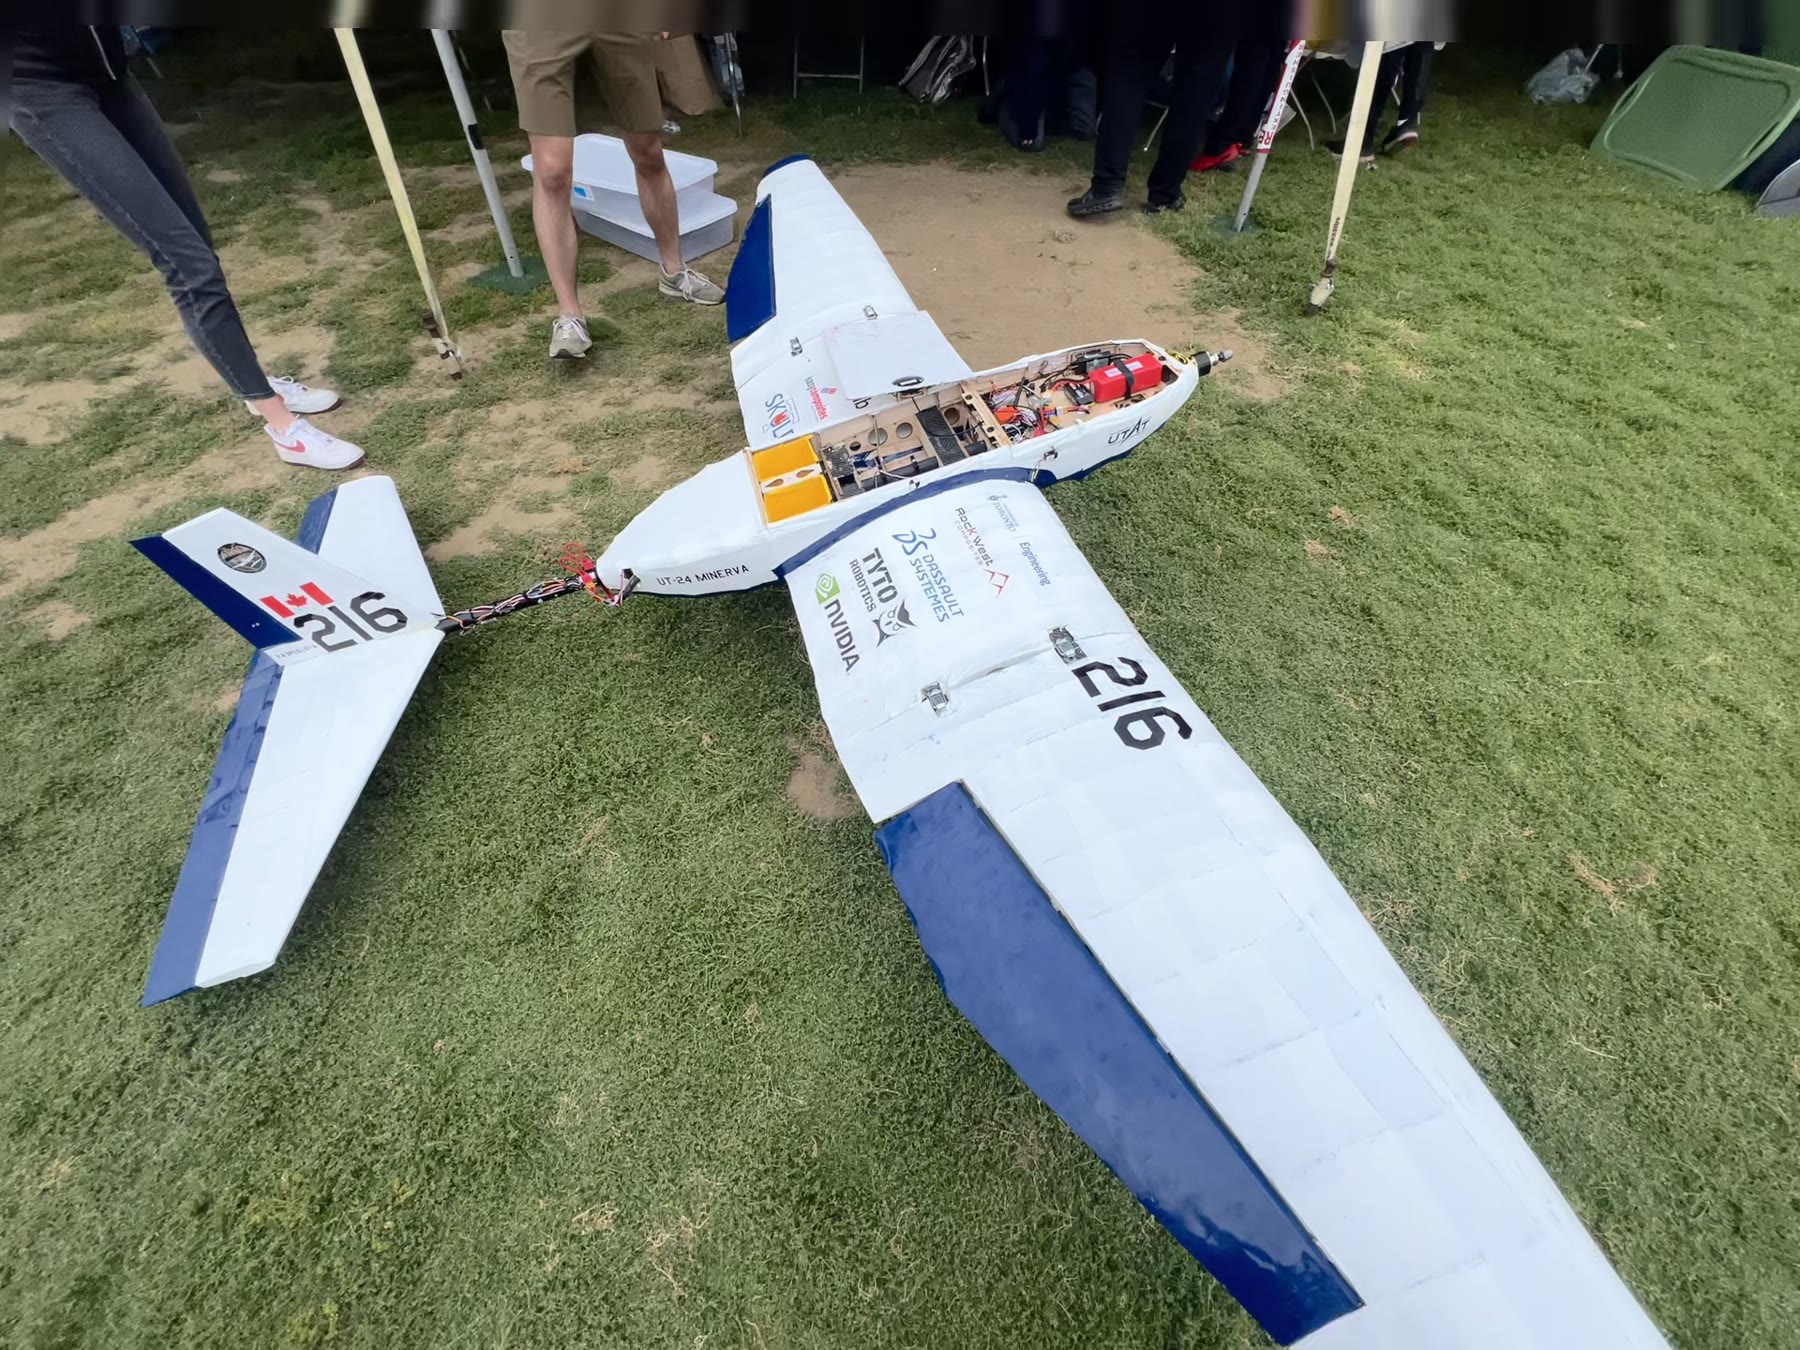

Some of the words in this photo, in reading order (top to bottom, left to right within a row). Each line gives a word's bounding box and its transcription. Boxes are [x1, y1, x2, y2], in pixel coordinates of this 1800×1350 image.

[953, 520, 984, 566] COMPOSITES
[972, 534, 994, 567] West
[1019, 541, 1052, 587] Engineering
[656, 575, 692, 586] UT-24
[695, 564, 750, 582] MINERVA
[849, 559, 877, 613] ROBOTICS
[862, 547, 899, 604] TYTO
[922, 553, 965, 618] DASSAULT
[293, 591, 408, 653] 216
[1071, 656, 1193, 751] 216
